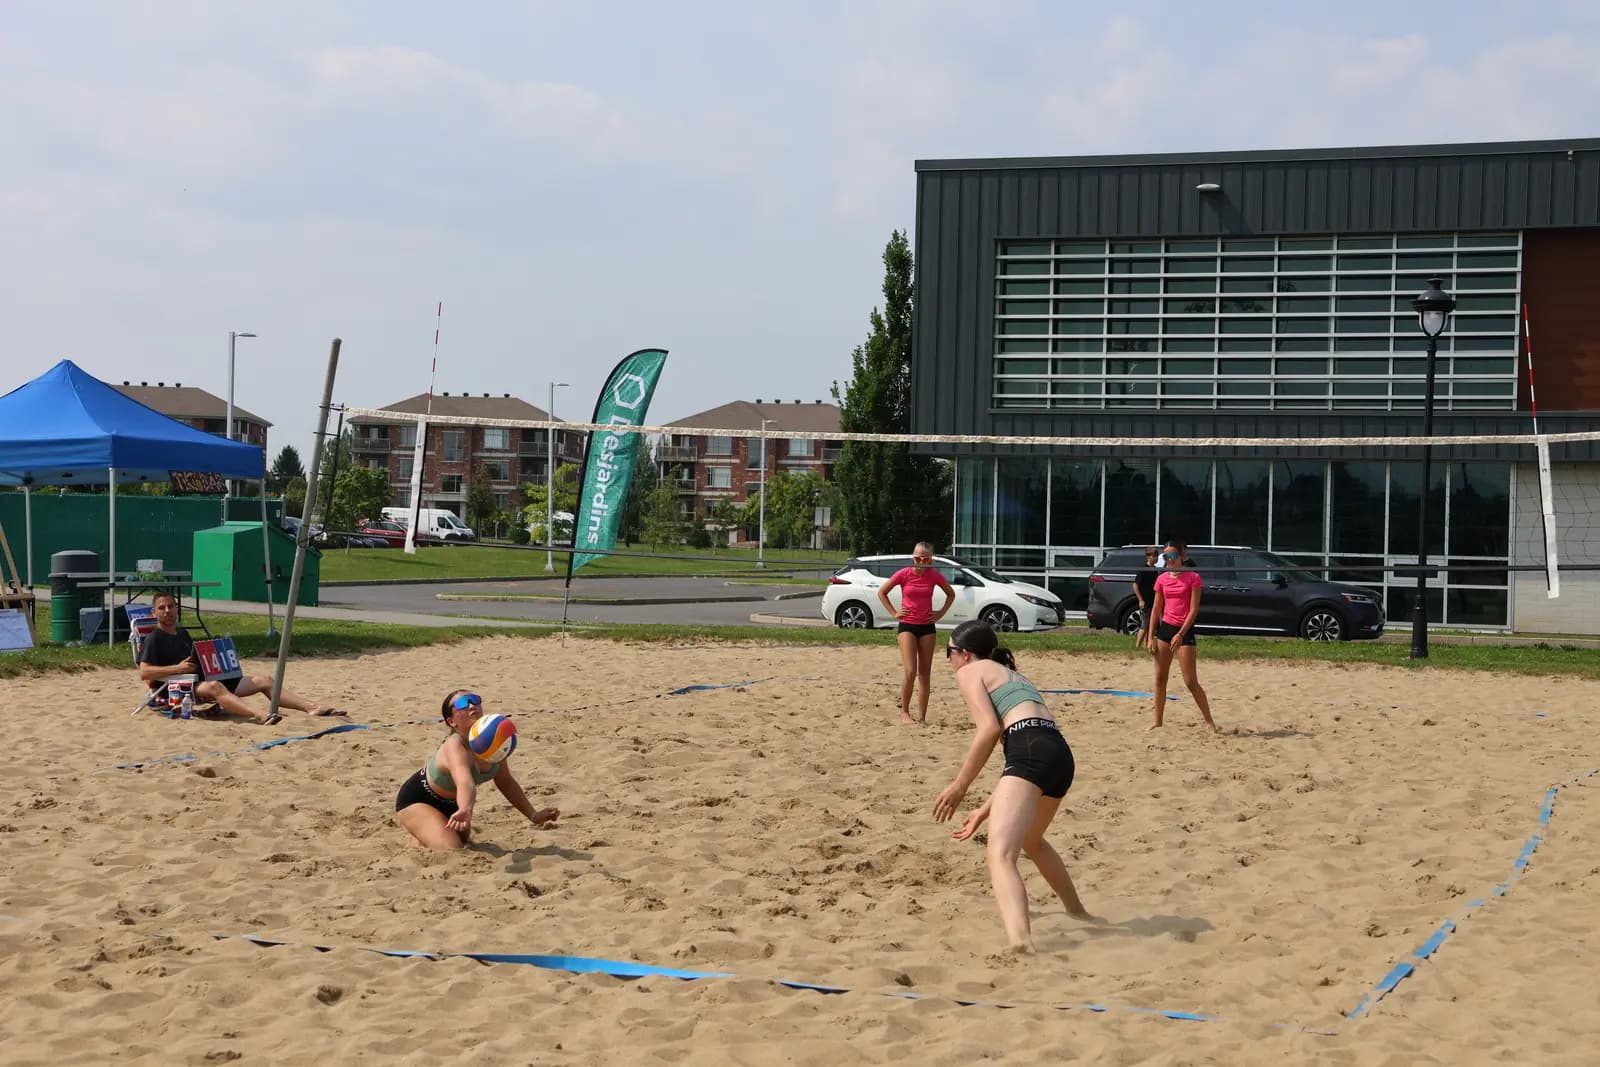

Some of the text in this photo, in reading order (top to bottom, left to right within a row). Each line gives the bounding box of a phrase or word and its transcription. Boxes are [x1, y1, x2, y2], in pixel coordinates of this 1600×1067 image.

[587, 415, 632, 545] Desjardins
[202, 653, 221, 673] 14
[1009, 719, 1039, 735] NIKE
